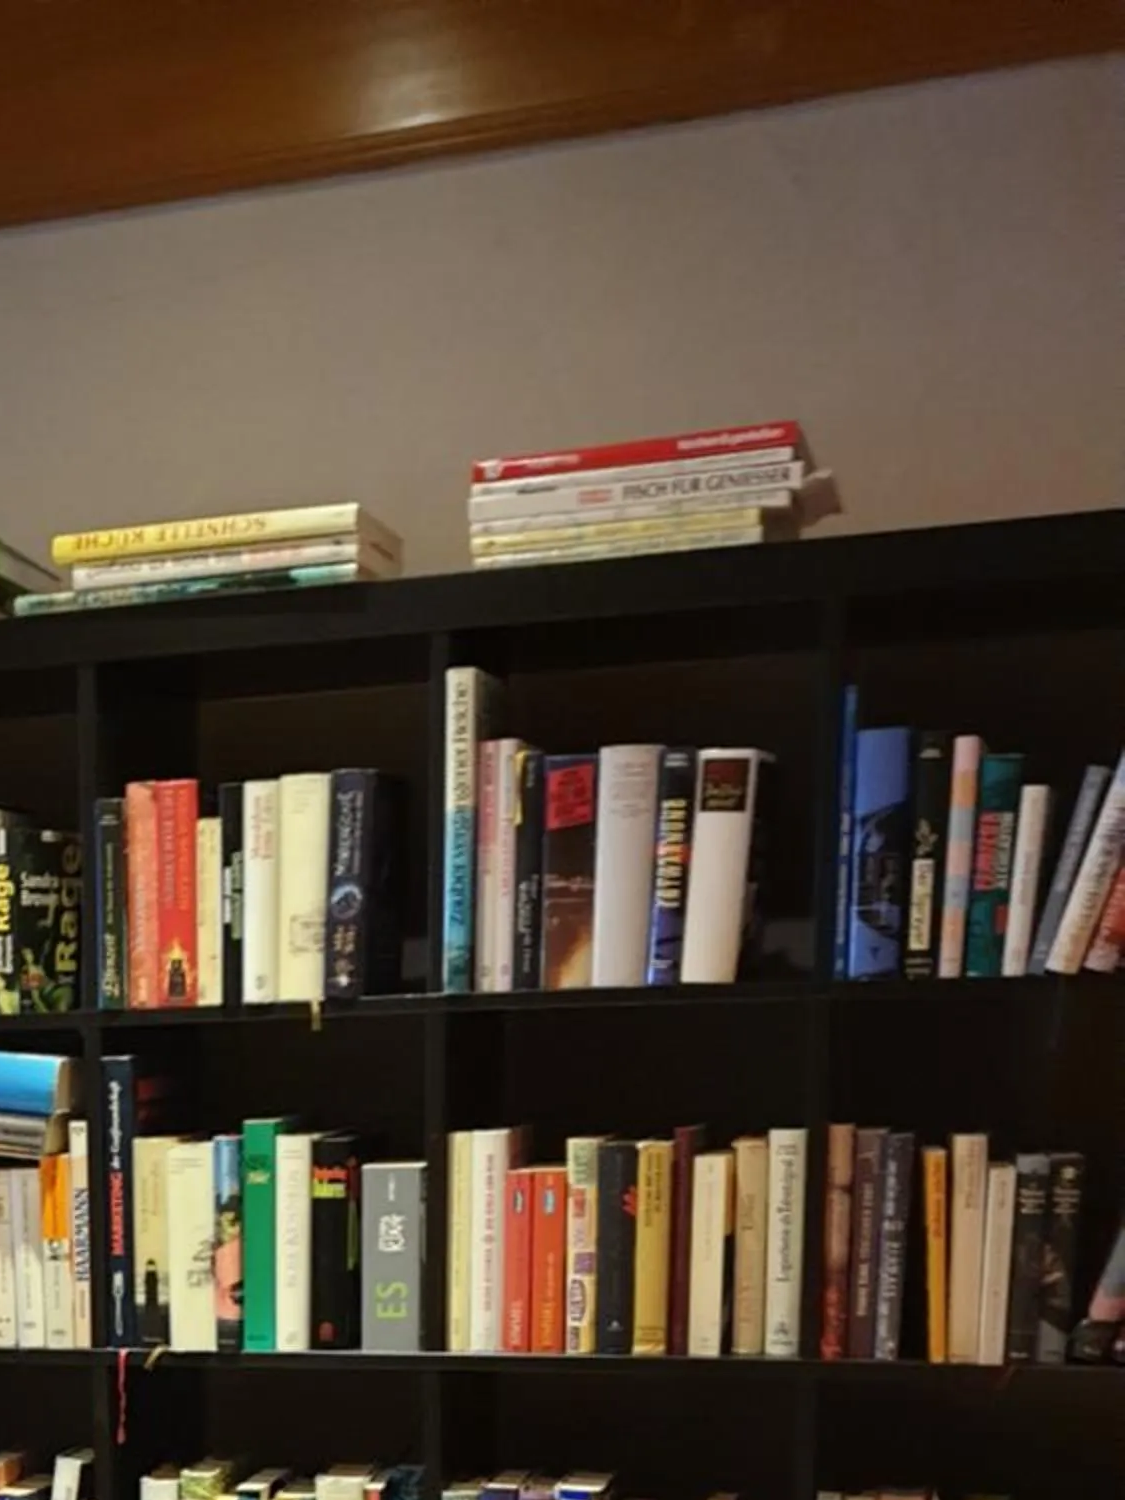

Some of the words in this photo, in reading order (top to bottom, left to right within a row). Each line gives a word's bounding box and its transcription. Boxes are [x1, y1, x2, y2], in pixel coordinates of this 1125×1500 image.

[54, 844, 84, 973] Rage
[449, 872, 467, 927] Zauber
[74, 1187, 89, 1282] HAARMANN
[112, 1172, 124, 1256] MARKETING
[375, 1282, 408, 1318] ES
